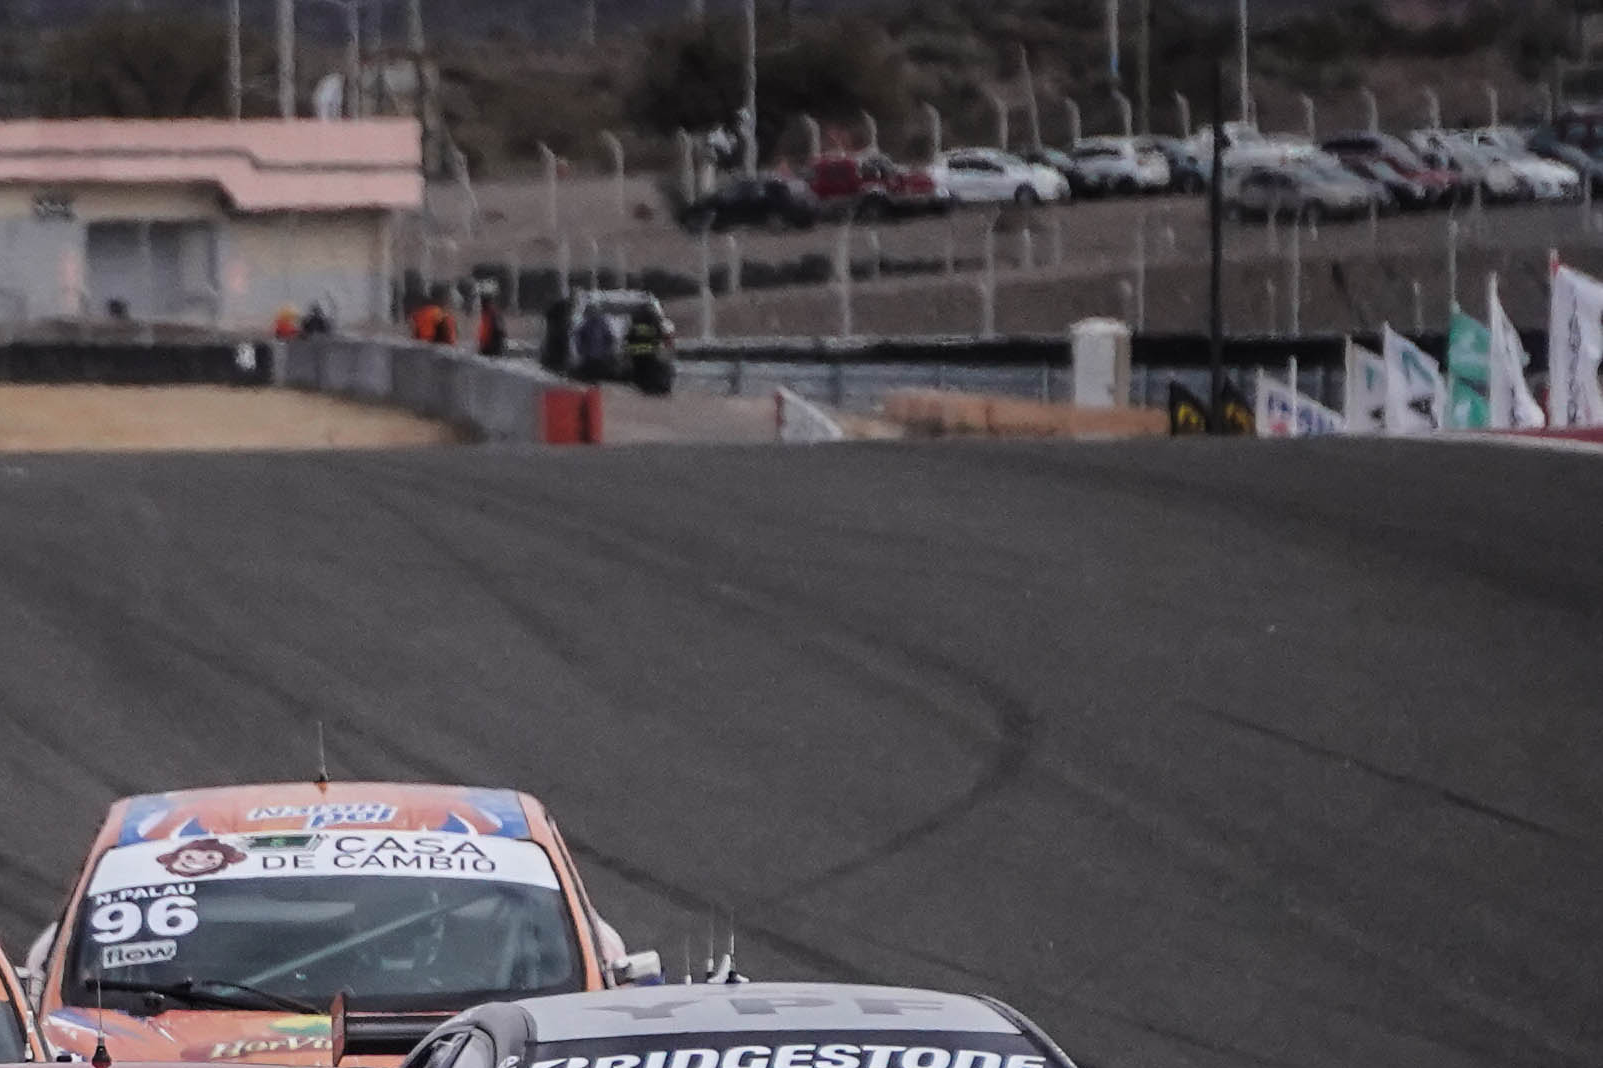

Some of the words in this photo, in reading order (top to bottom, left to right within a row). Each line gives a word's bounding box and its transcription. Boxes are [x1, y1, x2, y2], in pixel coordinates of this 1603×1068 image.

[334, 836, 488, 857] CASA
[262, 854, 316, 870] DE
[333, 853, 497, 873] CAMBIO
[92, 896, 199, 943] 96
